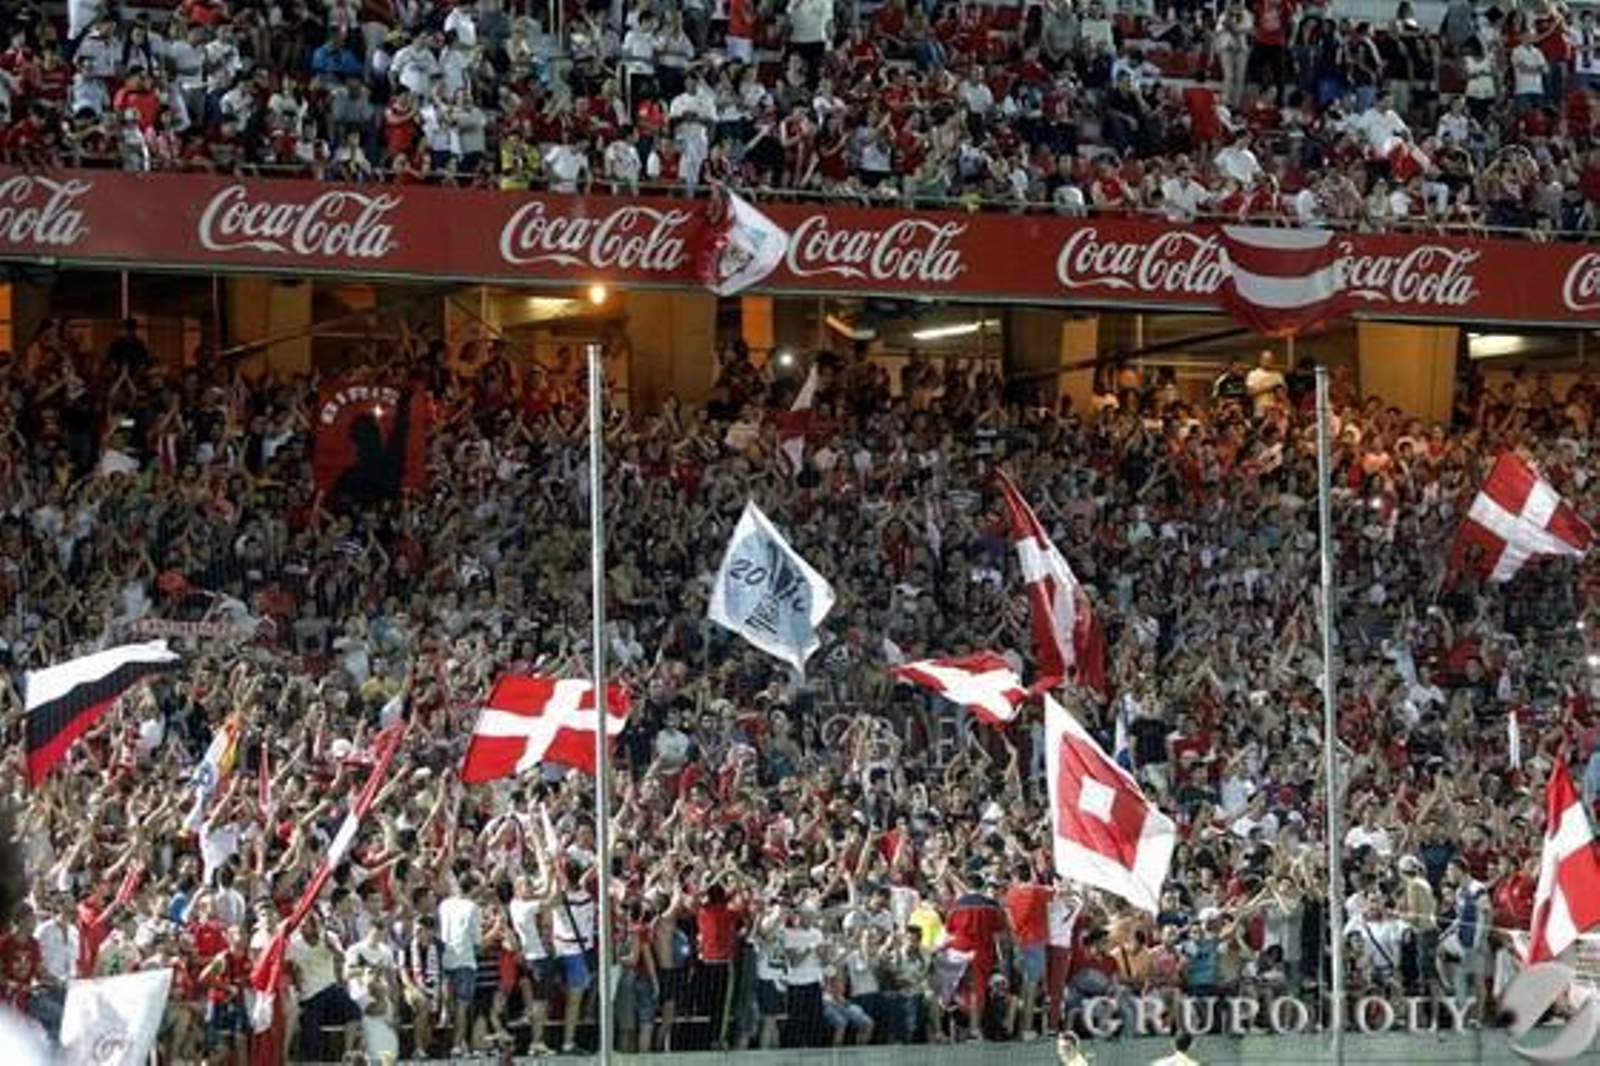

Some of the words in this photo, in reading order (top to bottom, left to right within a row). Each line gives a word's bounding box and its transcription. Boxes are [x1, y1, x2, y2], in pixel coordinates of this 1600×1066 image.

[198, 183, 402, 258] Coca-Cola
[499, 200, 693, 271] Coca-Cola
[786, 214, 968, 282] Coca-Cola
